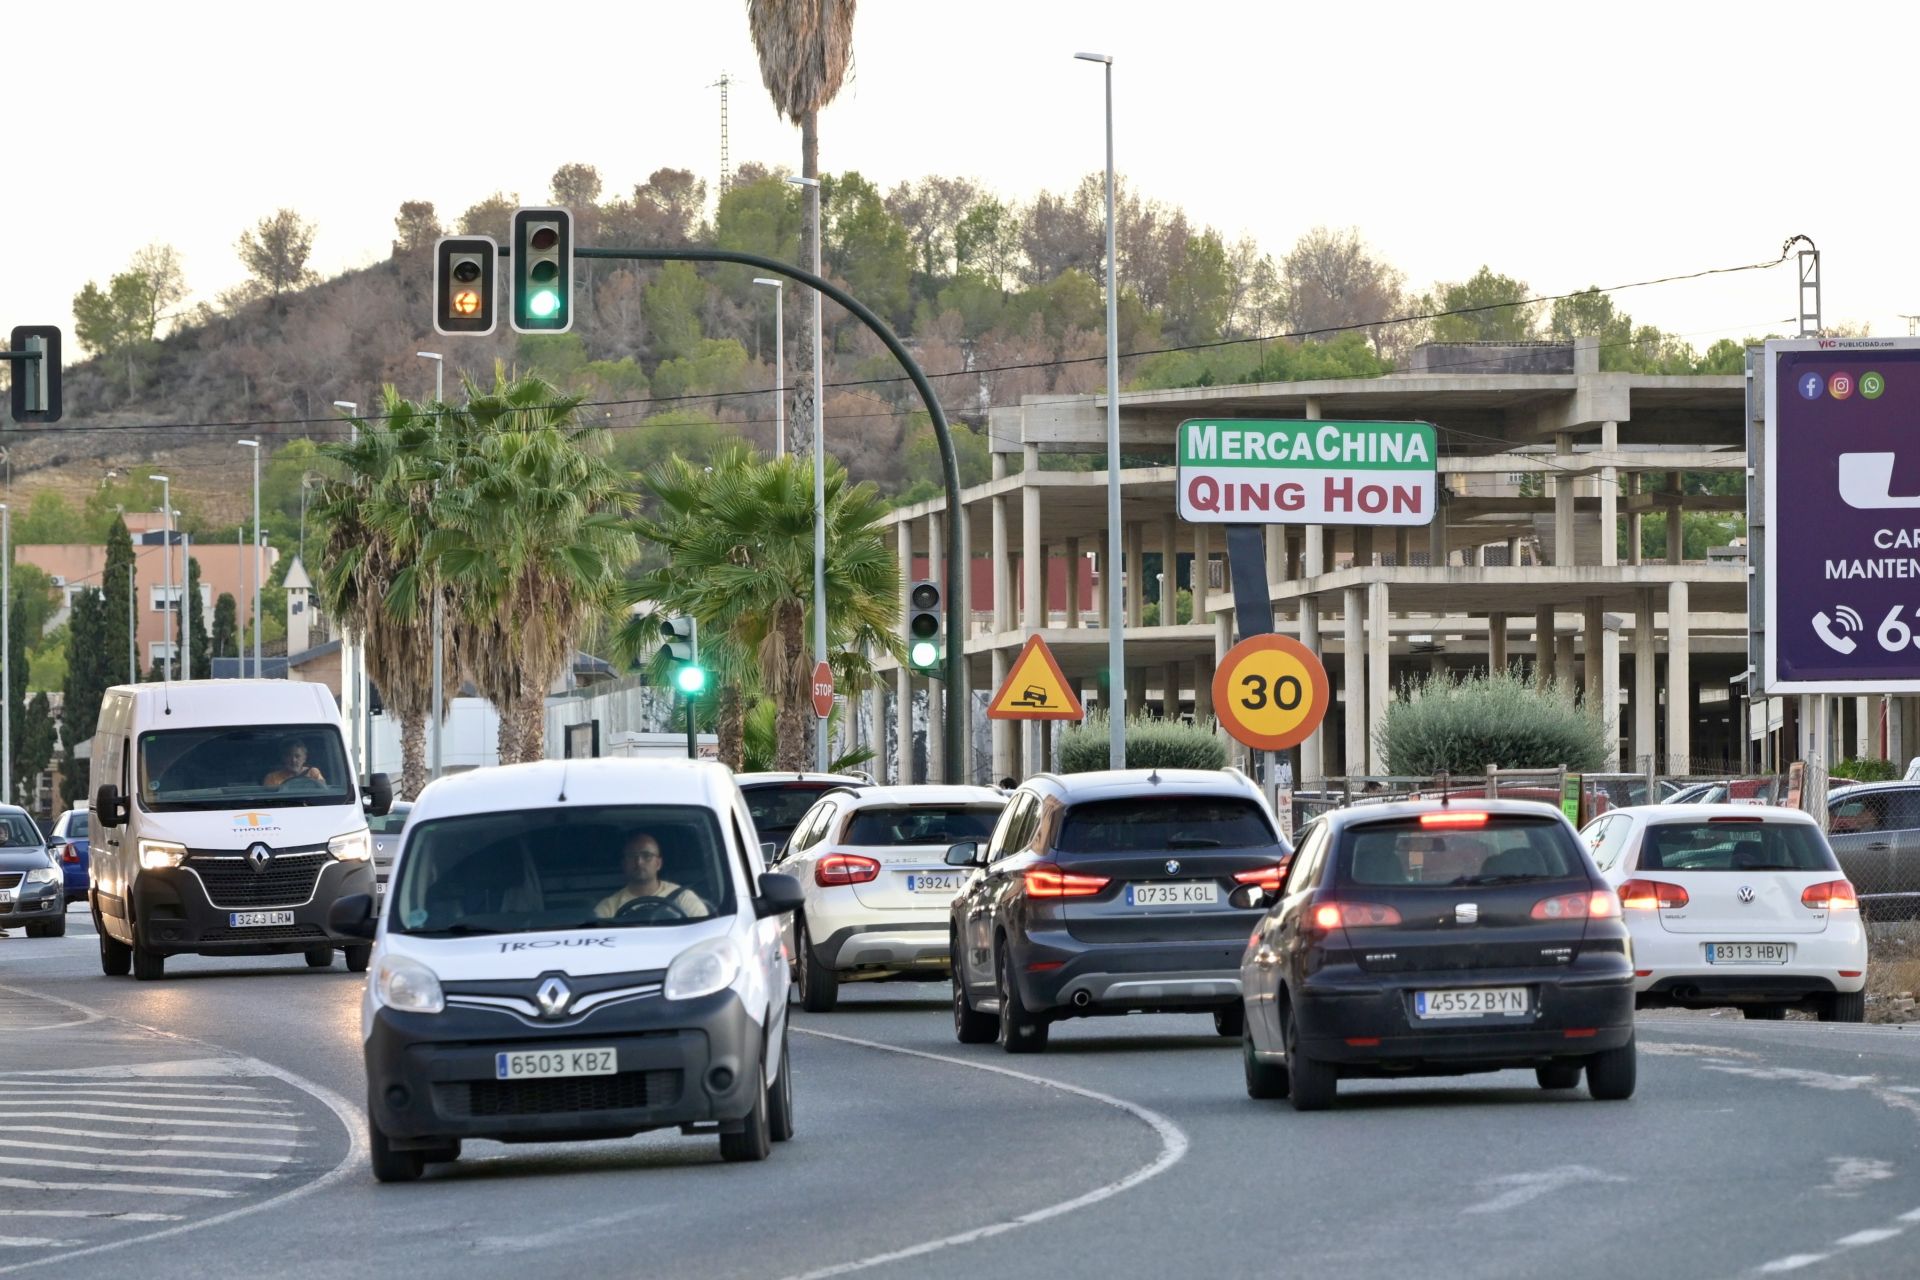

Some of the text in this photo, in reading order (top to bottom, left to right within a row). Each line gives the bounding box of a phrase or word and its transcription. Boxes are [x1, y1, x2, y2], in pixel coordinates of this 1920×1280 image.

[1838, 340, 1895, 348] PUBLICIDAD.com
[1187, 475, 1422, 514] QING HON
[815, 683, 832, 697] STOP
[1240, 674, 1303, 711] 30
[917, 876, 951, 889] 3924
[1137, 886, 1214, 903] 0735 KGL
[270, 912, 292, 924] LRM
[497, 936, 618, 954] TROUPE
[1716, 946, 1784, 959] 8313 HBV
[511, 1051, 612, 1075] 6503 KBZ
